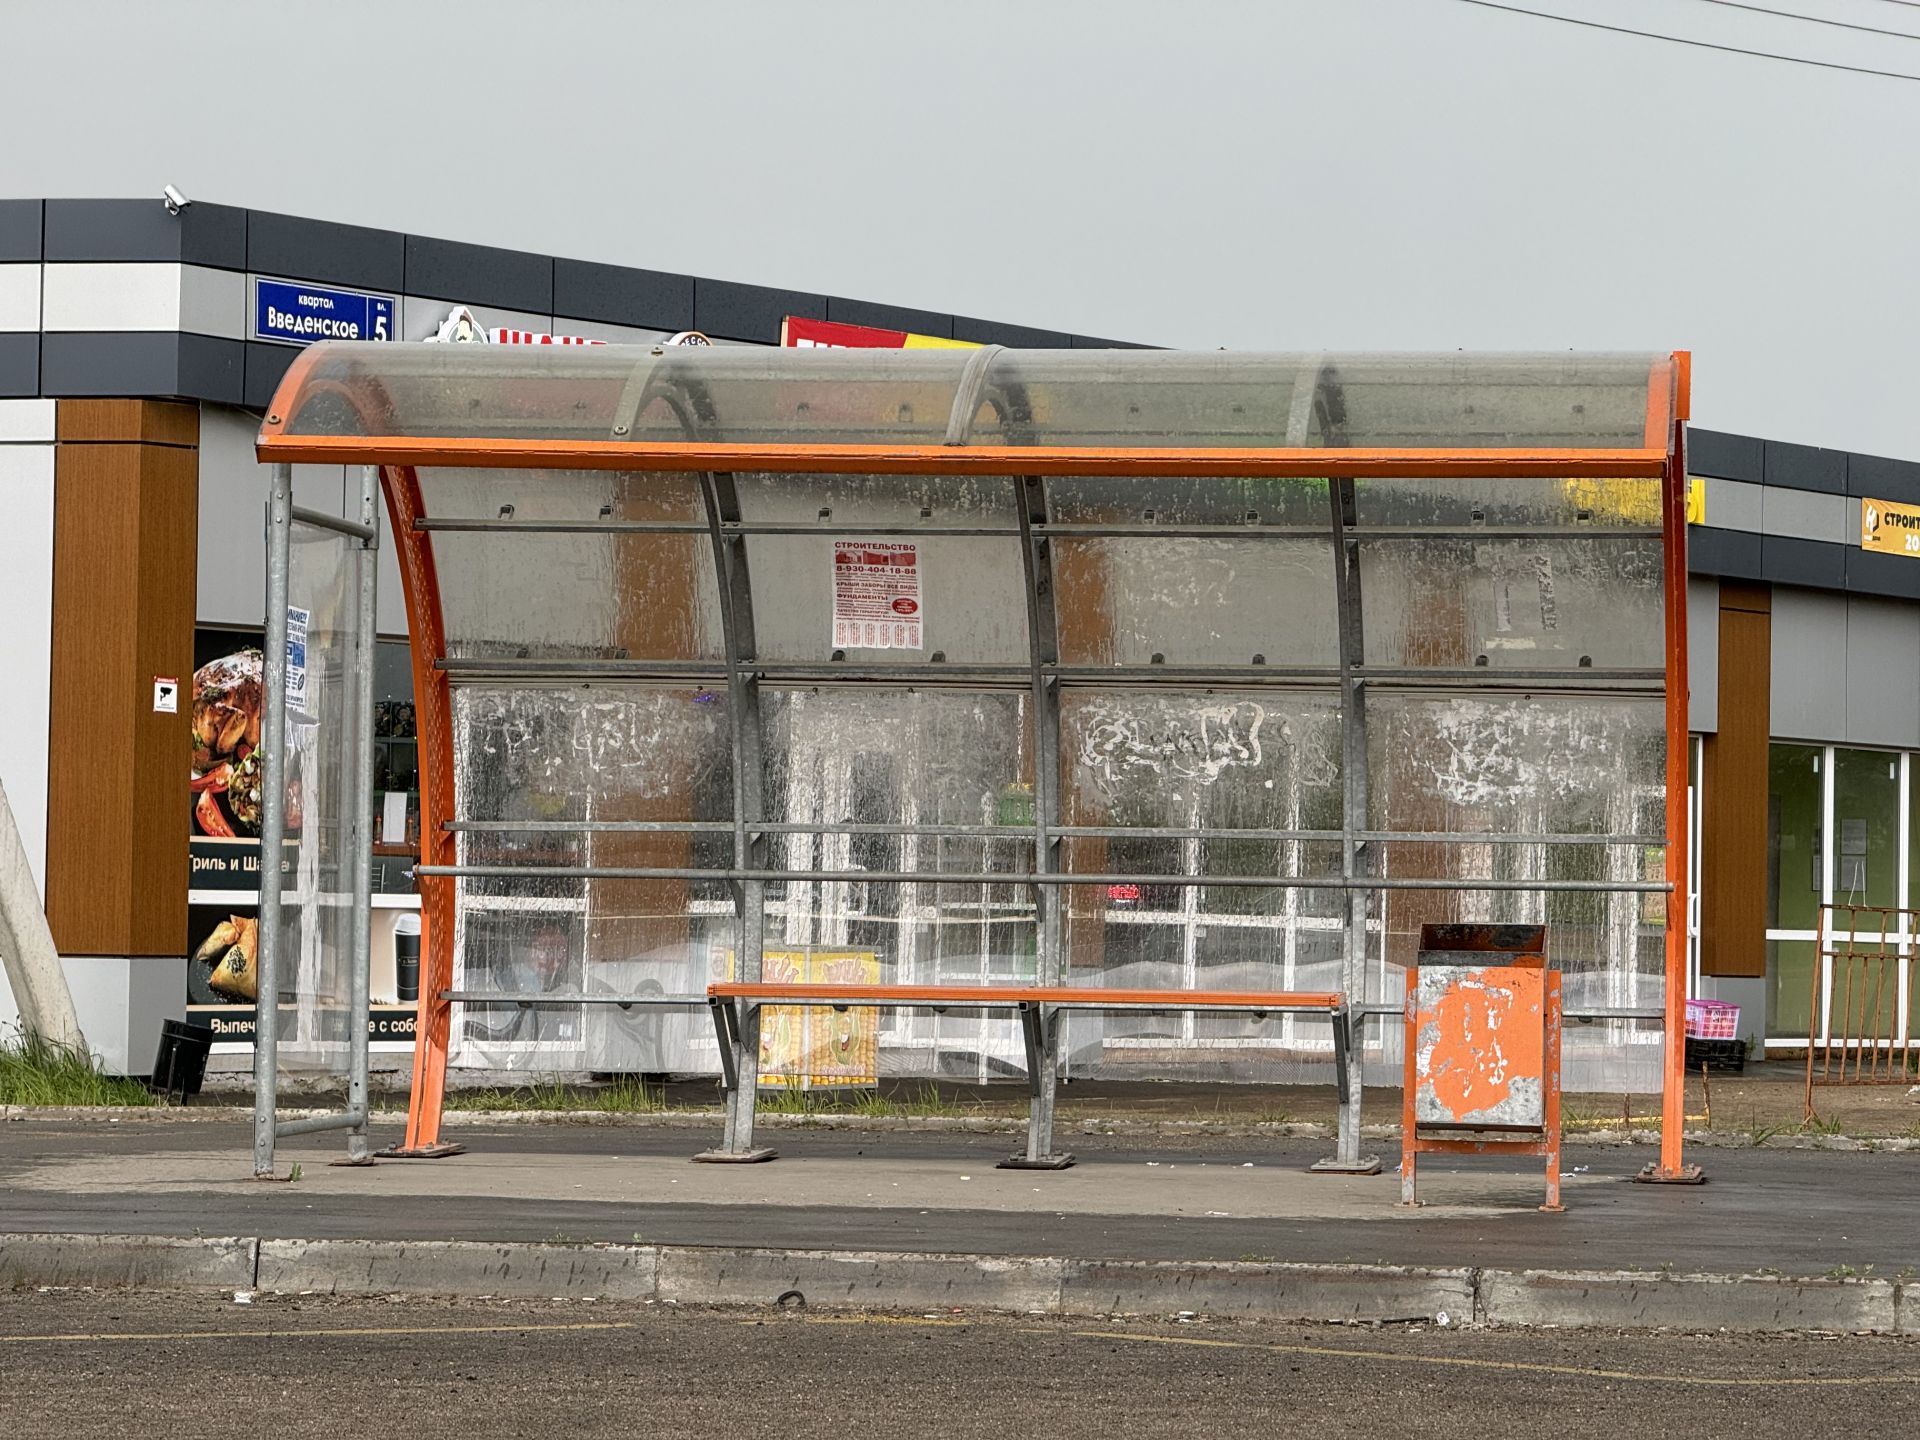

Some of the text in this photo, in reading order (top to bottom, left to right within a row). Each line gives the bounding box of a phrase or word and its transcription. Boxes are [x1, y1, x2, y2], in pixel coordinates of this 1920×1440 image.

[299, 294, 334, 309] квартал
[268, 306, 358, 339] Введенское
[374, 316, 387, 342] 5
[834, 541, 916, 551] СТРОИТЕЛЬСТВО
[836, 565, 916, 574] 8-930-404-18-88
[189, 854, 226, 872] риль
[230, 858, 239, 871] и
